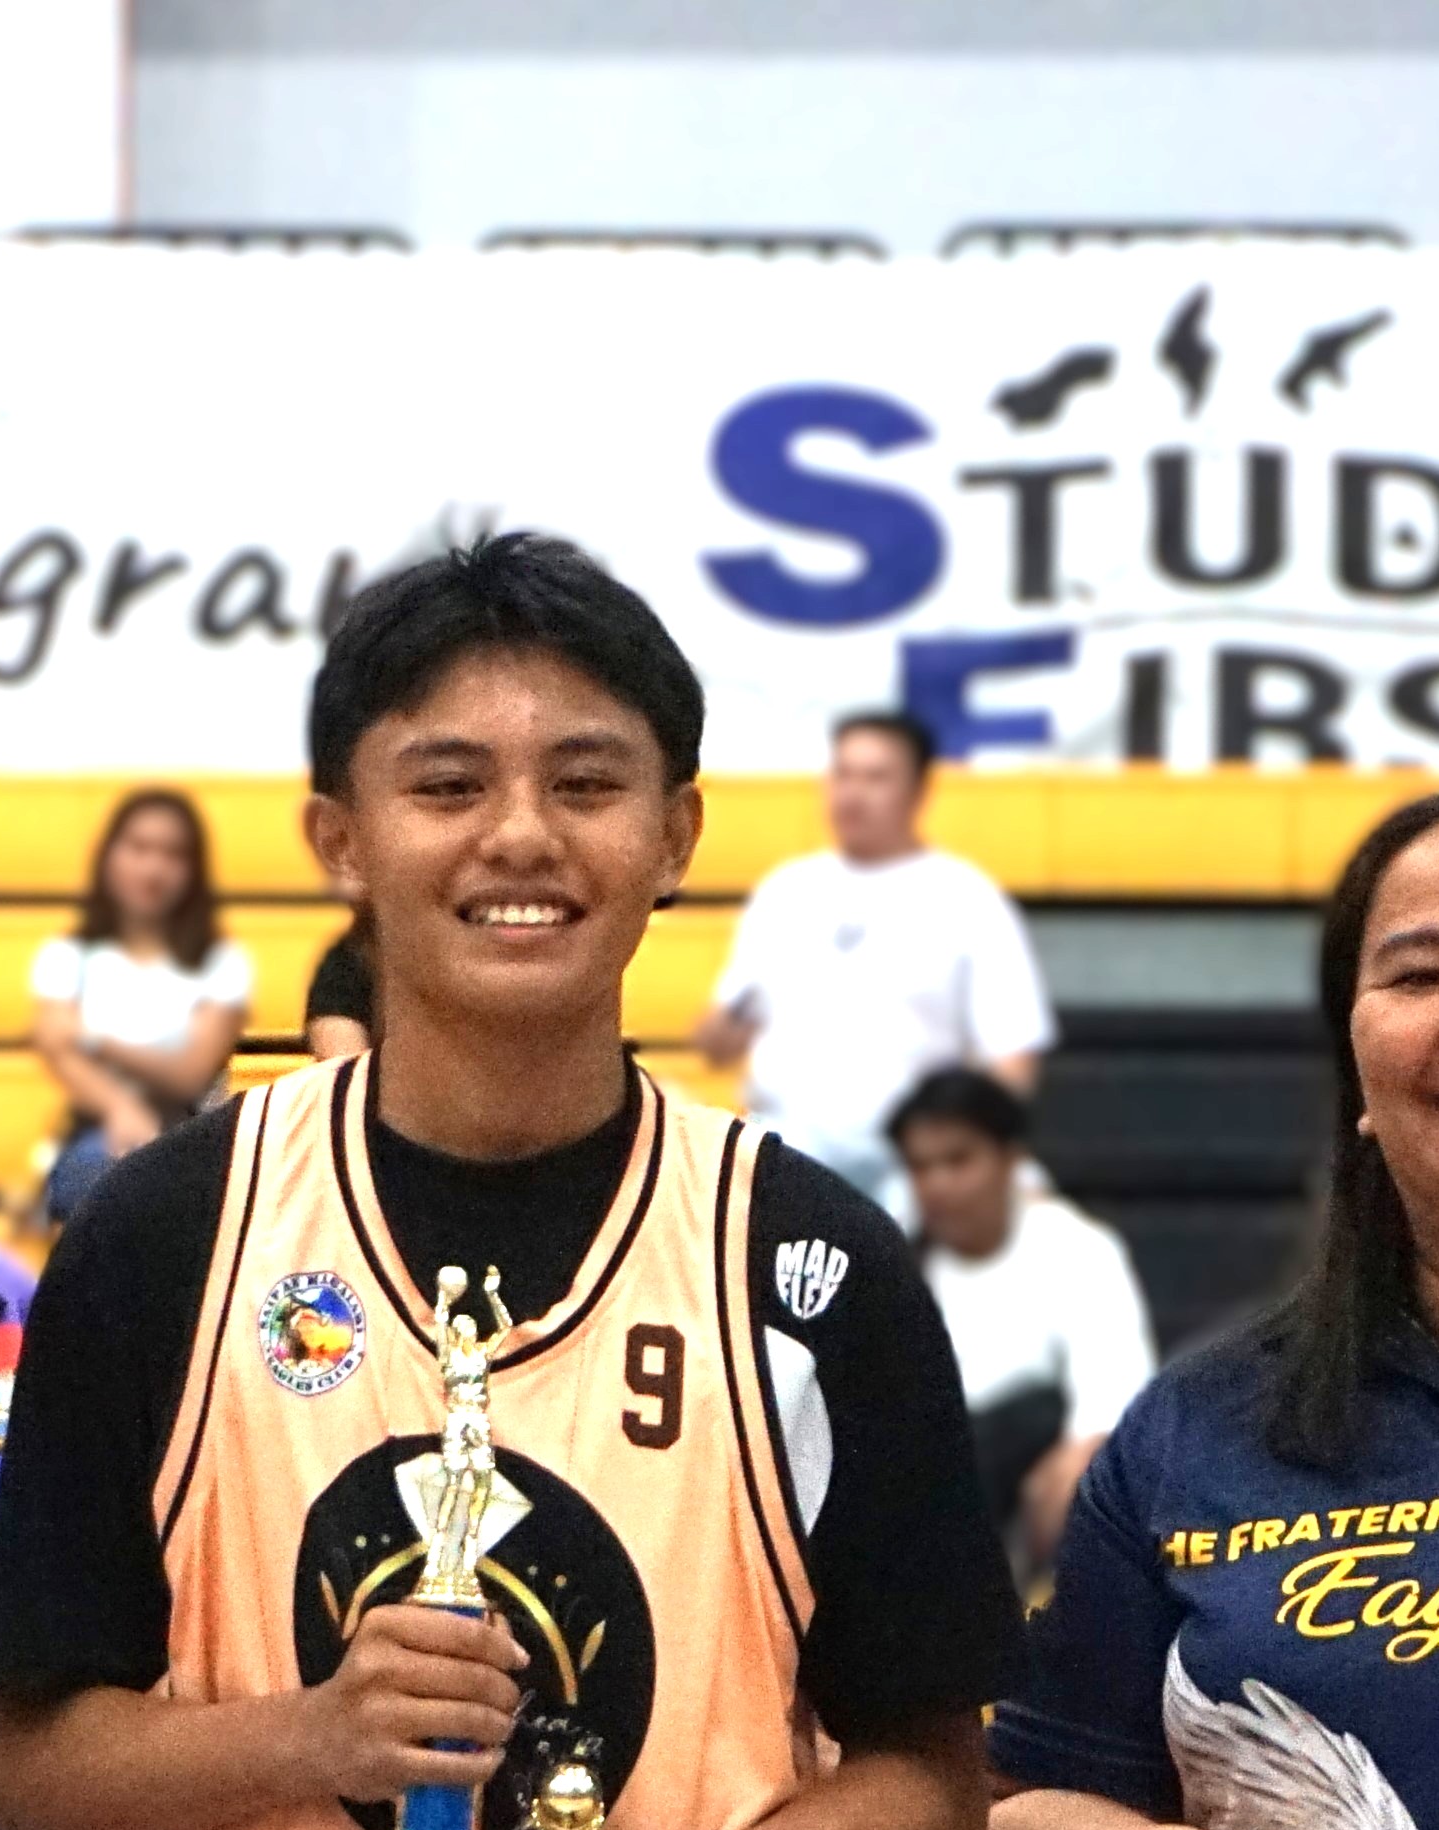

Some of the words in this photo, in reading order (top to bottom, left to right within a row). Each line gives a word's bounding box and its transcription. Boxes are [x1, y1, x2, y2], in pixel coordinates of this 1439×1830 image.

[776, 1238, 849, 1282] MAD
[621, 1323, 686, 1449] 9
[1164, 1531, 1219, 1567] HE
